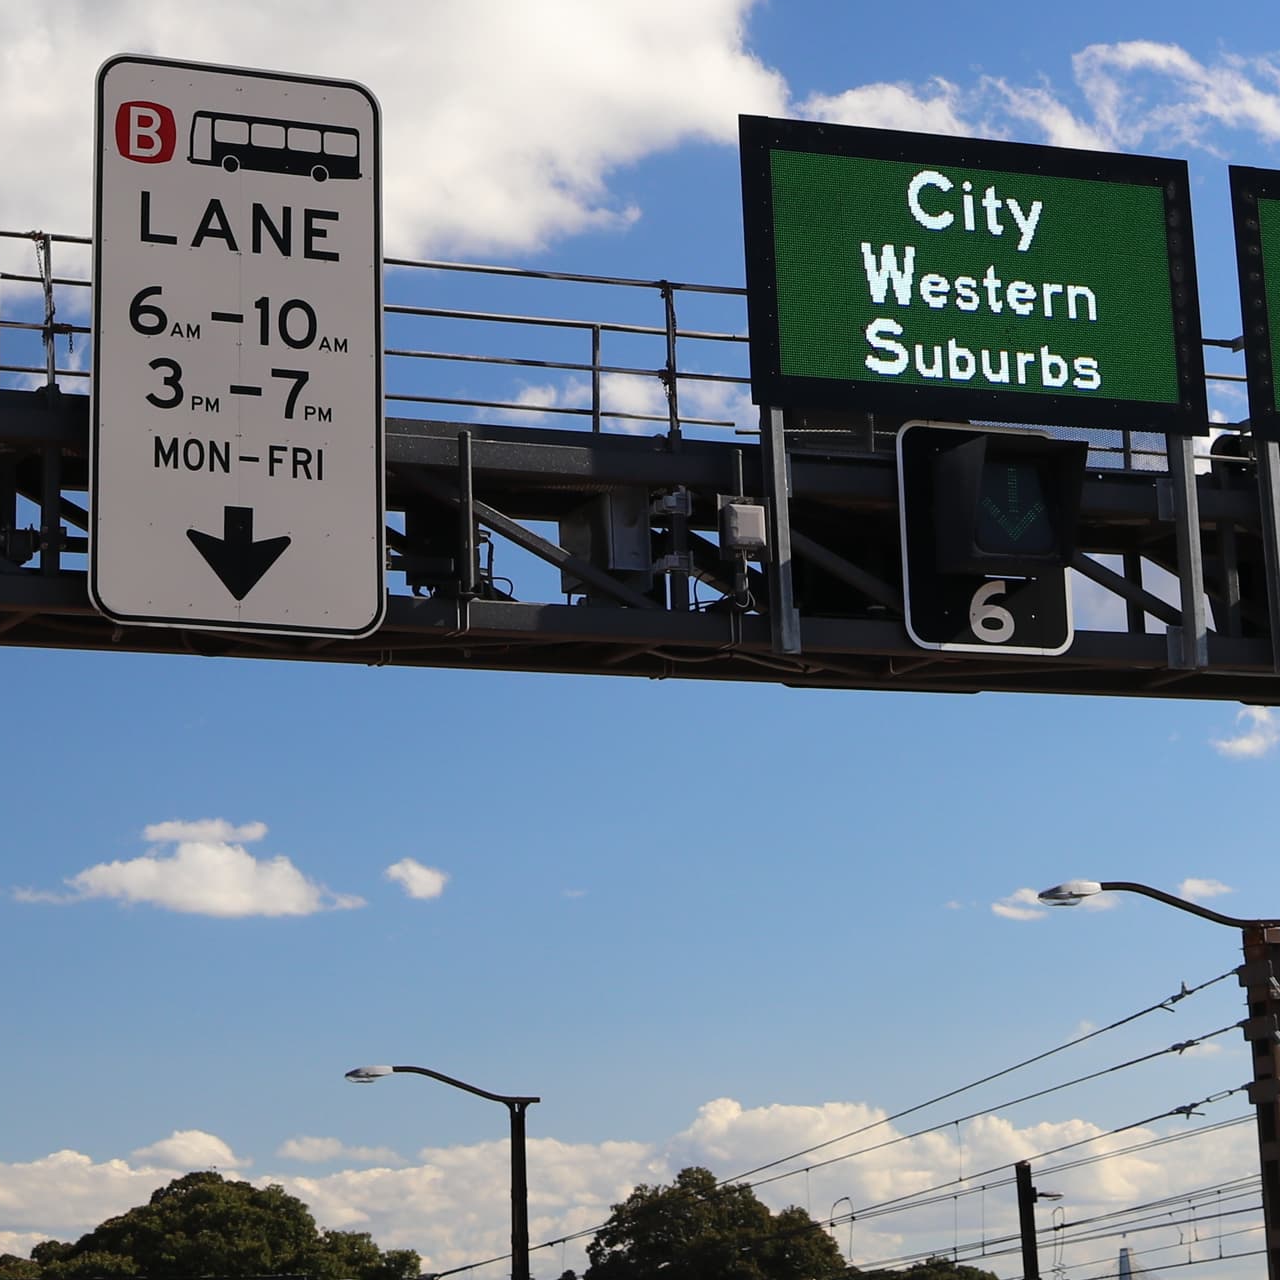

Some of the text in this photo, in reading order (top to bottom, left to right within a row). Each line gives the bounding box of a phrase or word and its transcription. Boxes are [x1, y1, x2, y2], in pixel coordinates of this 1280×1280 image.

[130, 106, 162, 157] B
[139, 191, 341, 262] LANE
[907, 169, 1044, 252] City
[859, 241, 1099, 322] Western
[863, 317, 1102, 391] Suburbs
[968, 580, 1016, 643] 6
